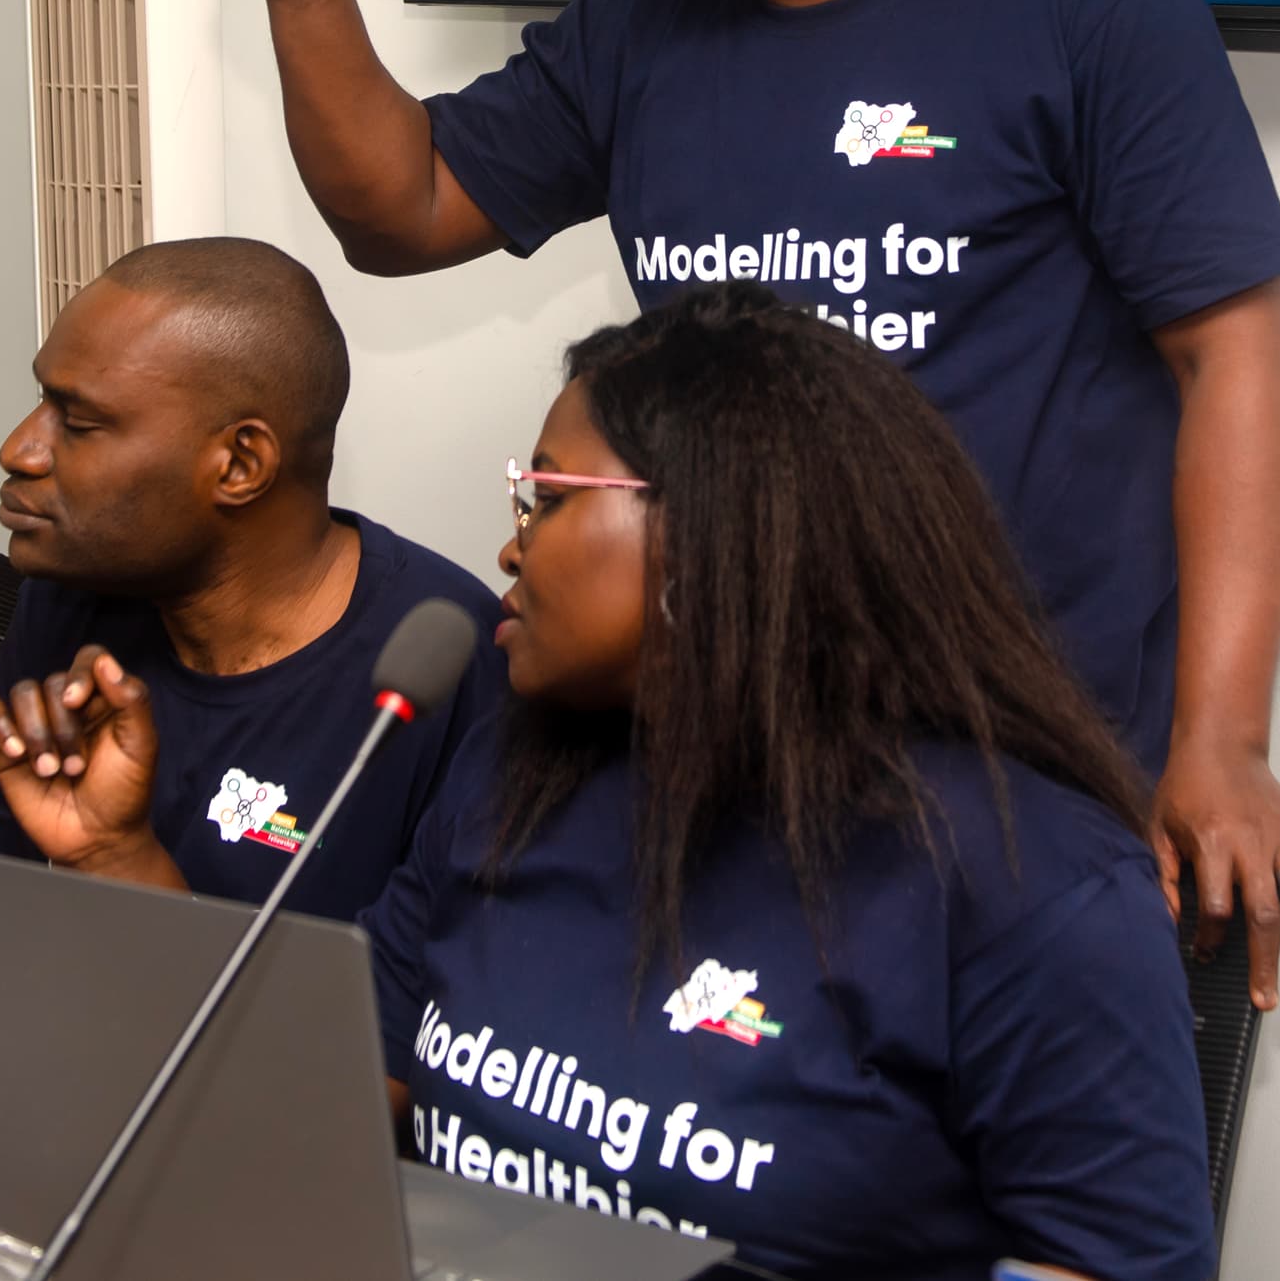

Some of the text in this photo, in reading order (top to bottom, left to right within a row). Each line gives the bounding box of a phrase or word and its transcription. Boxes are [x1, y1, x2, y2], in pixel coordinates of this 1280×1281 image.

[634, 222, 971, 295] Modelling for
[414, 999, 775, 1192] Modelling for
